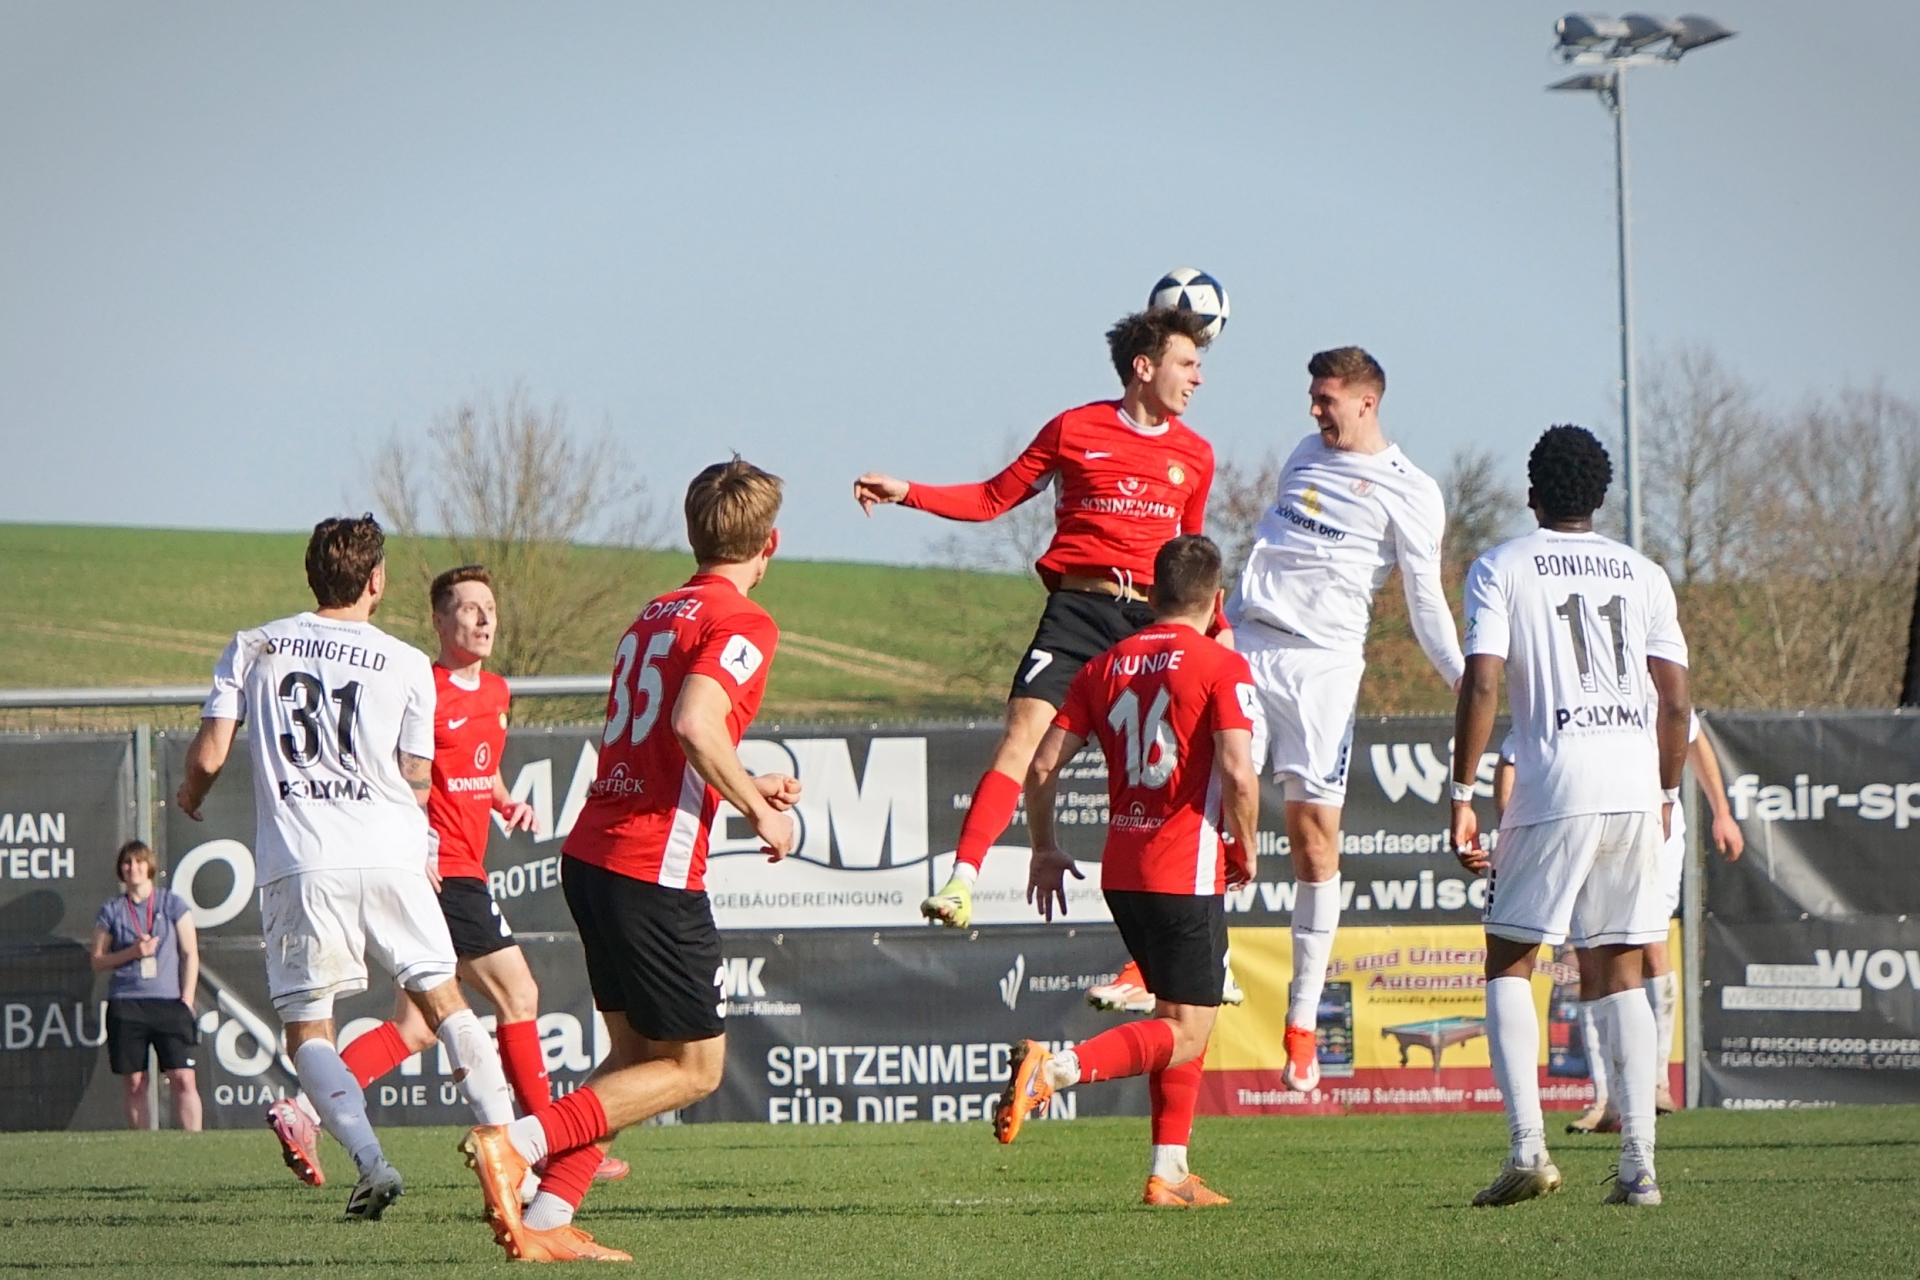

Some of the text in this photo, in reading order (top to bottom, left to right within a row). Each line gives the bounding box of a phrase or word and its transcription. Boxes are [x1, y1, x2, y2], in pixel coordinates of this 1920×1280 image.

[1534, 554, 1634, 581] BONIANGA
[266, 637, 386, 672] SPRINGFELD
[1556, 593, 1632, 695] 11
[1024, 649, 1053, 683] 7
[1112, 650, 1185, 676] KUNDE
[603, 629, 677, 746] 35
[279, 671, 364, 772] 31
[1556, 705, 1643, 731] POLYMA
[1107, 682, 1178, 790] 16
[279, 779, 373, 801] POLYMA
[1727, 773, 1920, 829] fair-sp
[1337, 829, 1451, 855] lasfaser!
[713, 888, 905, 910] GEBÄUDEREINIGUNG
[1354, 950, 1399, 972] und
[1367, 971, 1488, 991] Automate
[0, 1001, 108, 1050] BAU
[766, 1040, 1086, 1087] SPITZENMED
[380, 1085, 427, 1106] DIE
